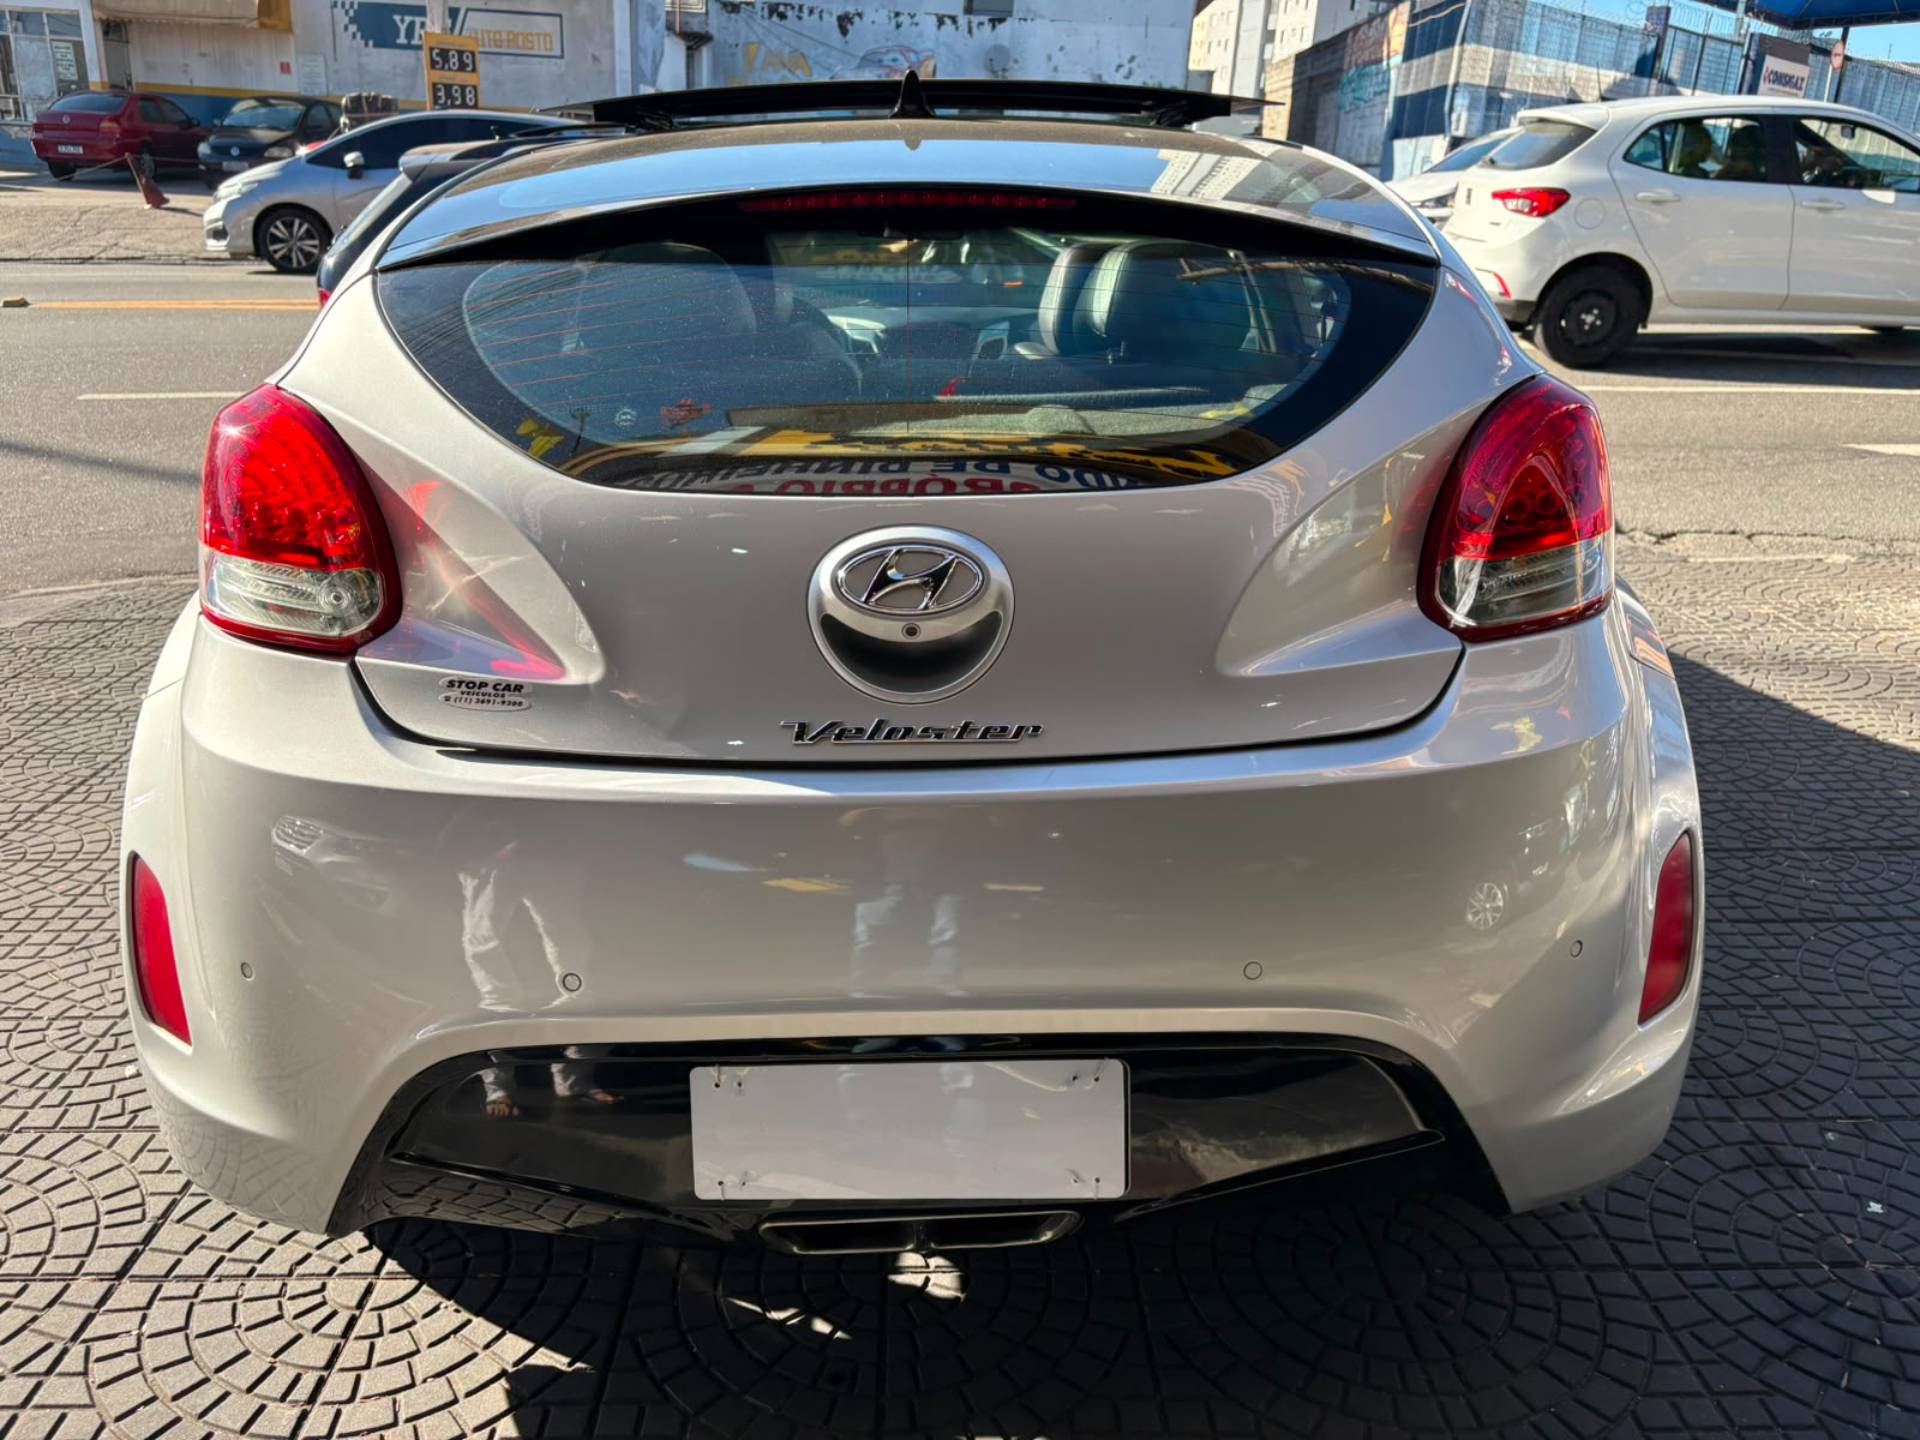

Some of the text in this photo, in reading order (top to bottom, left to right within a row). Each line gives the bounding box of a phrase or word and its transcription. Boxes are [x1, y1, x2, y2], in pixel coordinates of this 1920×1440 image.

[507, 31, 554, 52] POSTO
[431, 48, 473, 71] 5,89
[435, 84, 476, 106] 3,98
[446, 680, 524, 693] STOP CAR
[454, 696, 472, 704] (11)
[779, 717, 1045, 745] Veloster
